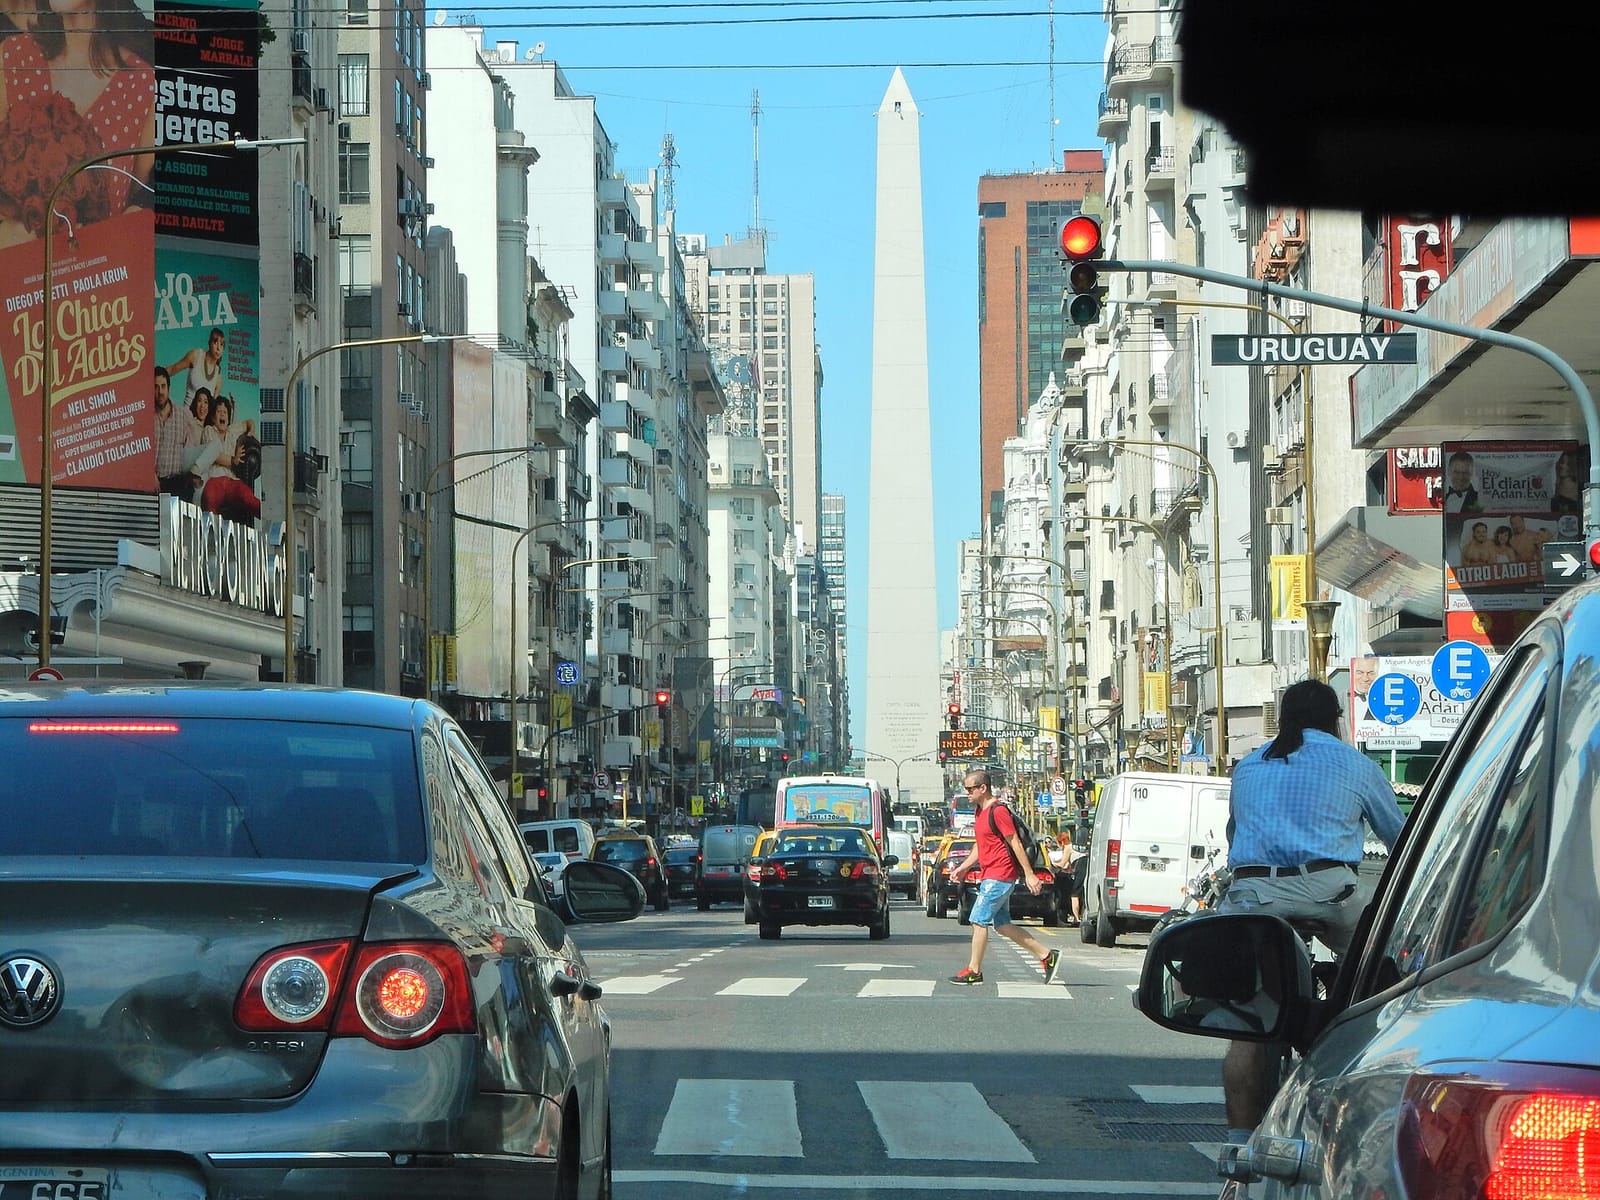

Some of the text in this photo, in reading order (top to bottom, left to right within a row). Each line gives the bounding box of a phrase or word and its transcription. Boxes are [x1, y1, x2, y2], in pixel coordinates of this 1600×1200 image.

[209, 37, 245, 51] JORGE
[200, 50, 253, 67] MARRALE
[155, 77, 236, 115] stras
[165, 161, 208, 177] ASSOUS
[215, 203, 231, 213] DEL
[182, 216, 225, 233] DAULTE
[6, 294, 34, 313] DIEGO
[73, 273, 102, 294] PAOLA
[102, 265, 129, 286] KRUM
[56, 295, 134, 341] Chica
[1238, 337, 1391, 361] URUGUAY
[67, 400, 88, 418] NEIL
[89, 389, 117, 411] SIMON
[81, 411, 111, 428] FERNANDO
[66, 452, 105, 477] CLAUDIO
[104, 436, 152, 464] TOLCACHIR
[1481, 469, 1500, 479] Hoy
[1483, 477, 1494, 490] El
[1457, 566, 1490, 583] OTRO
[1494, 562, 1528, 580] LADO
[1450, 648, 1473, 680] E
[1384, 677, 1405, 706] E
[951, 732, 979, 740] FELIZ
[982, 730, 1035, 739] TALCAHUANO
[1133, 787, 1149, 800] 110
